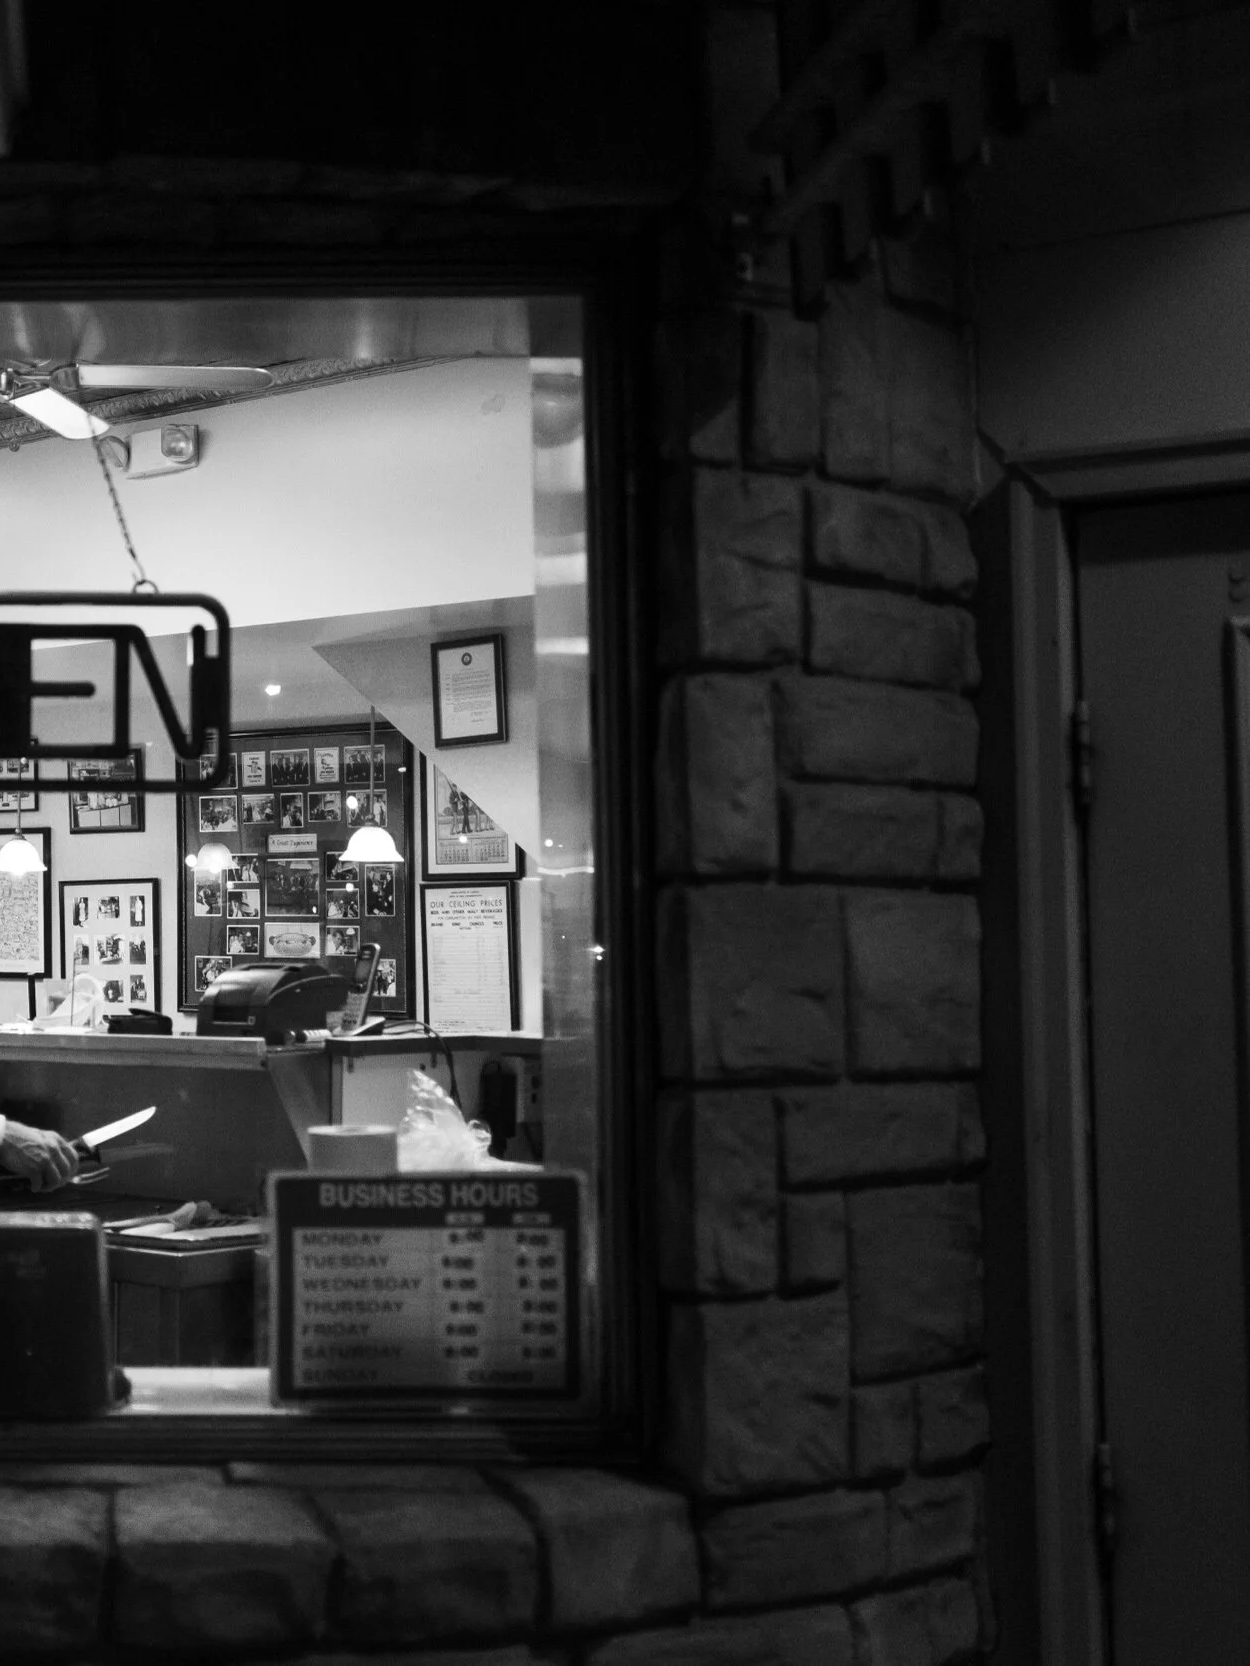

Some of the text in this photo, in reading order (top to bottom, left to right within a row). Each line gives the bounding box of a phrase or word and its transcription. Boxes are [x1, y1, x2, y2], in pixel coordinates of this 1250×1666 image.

[430, 899, 503, 909] OUR CEILING PRICES
[319, 1182, 540, 1208] BUSINESS HOURS
[302, 1233, 383, 1246] MONDAY
[302, 1255, 389, 1269] TUESDAY
[302, 1277, 422, 1291] WEDNESDAY
